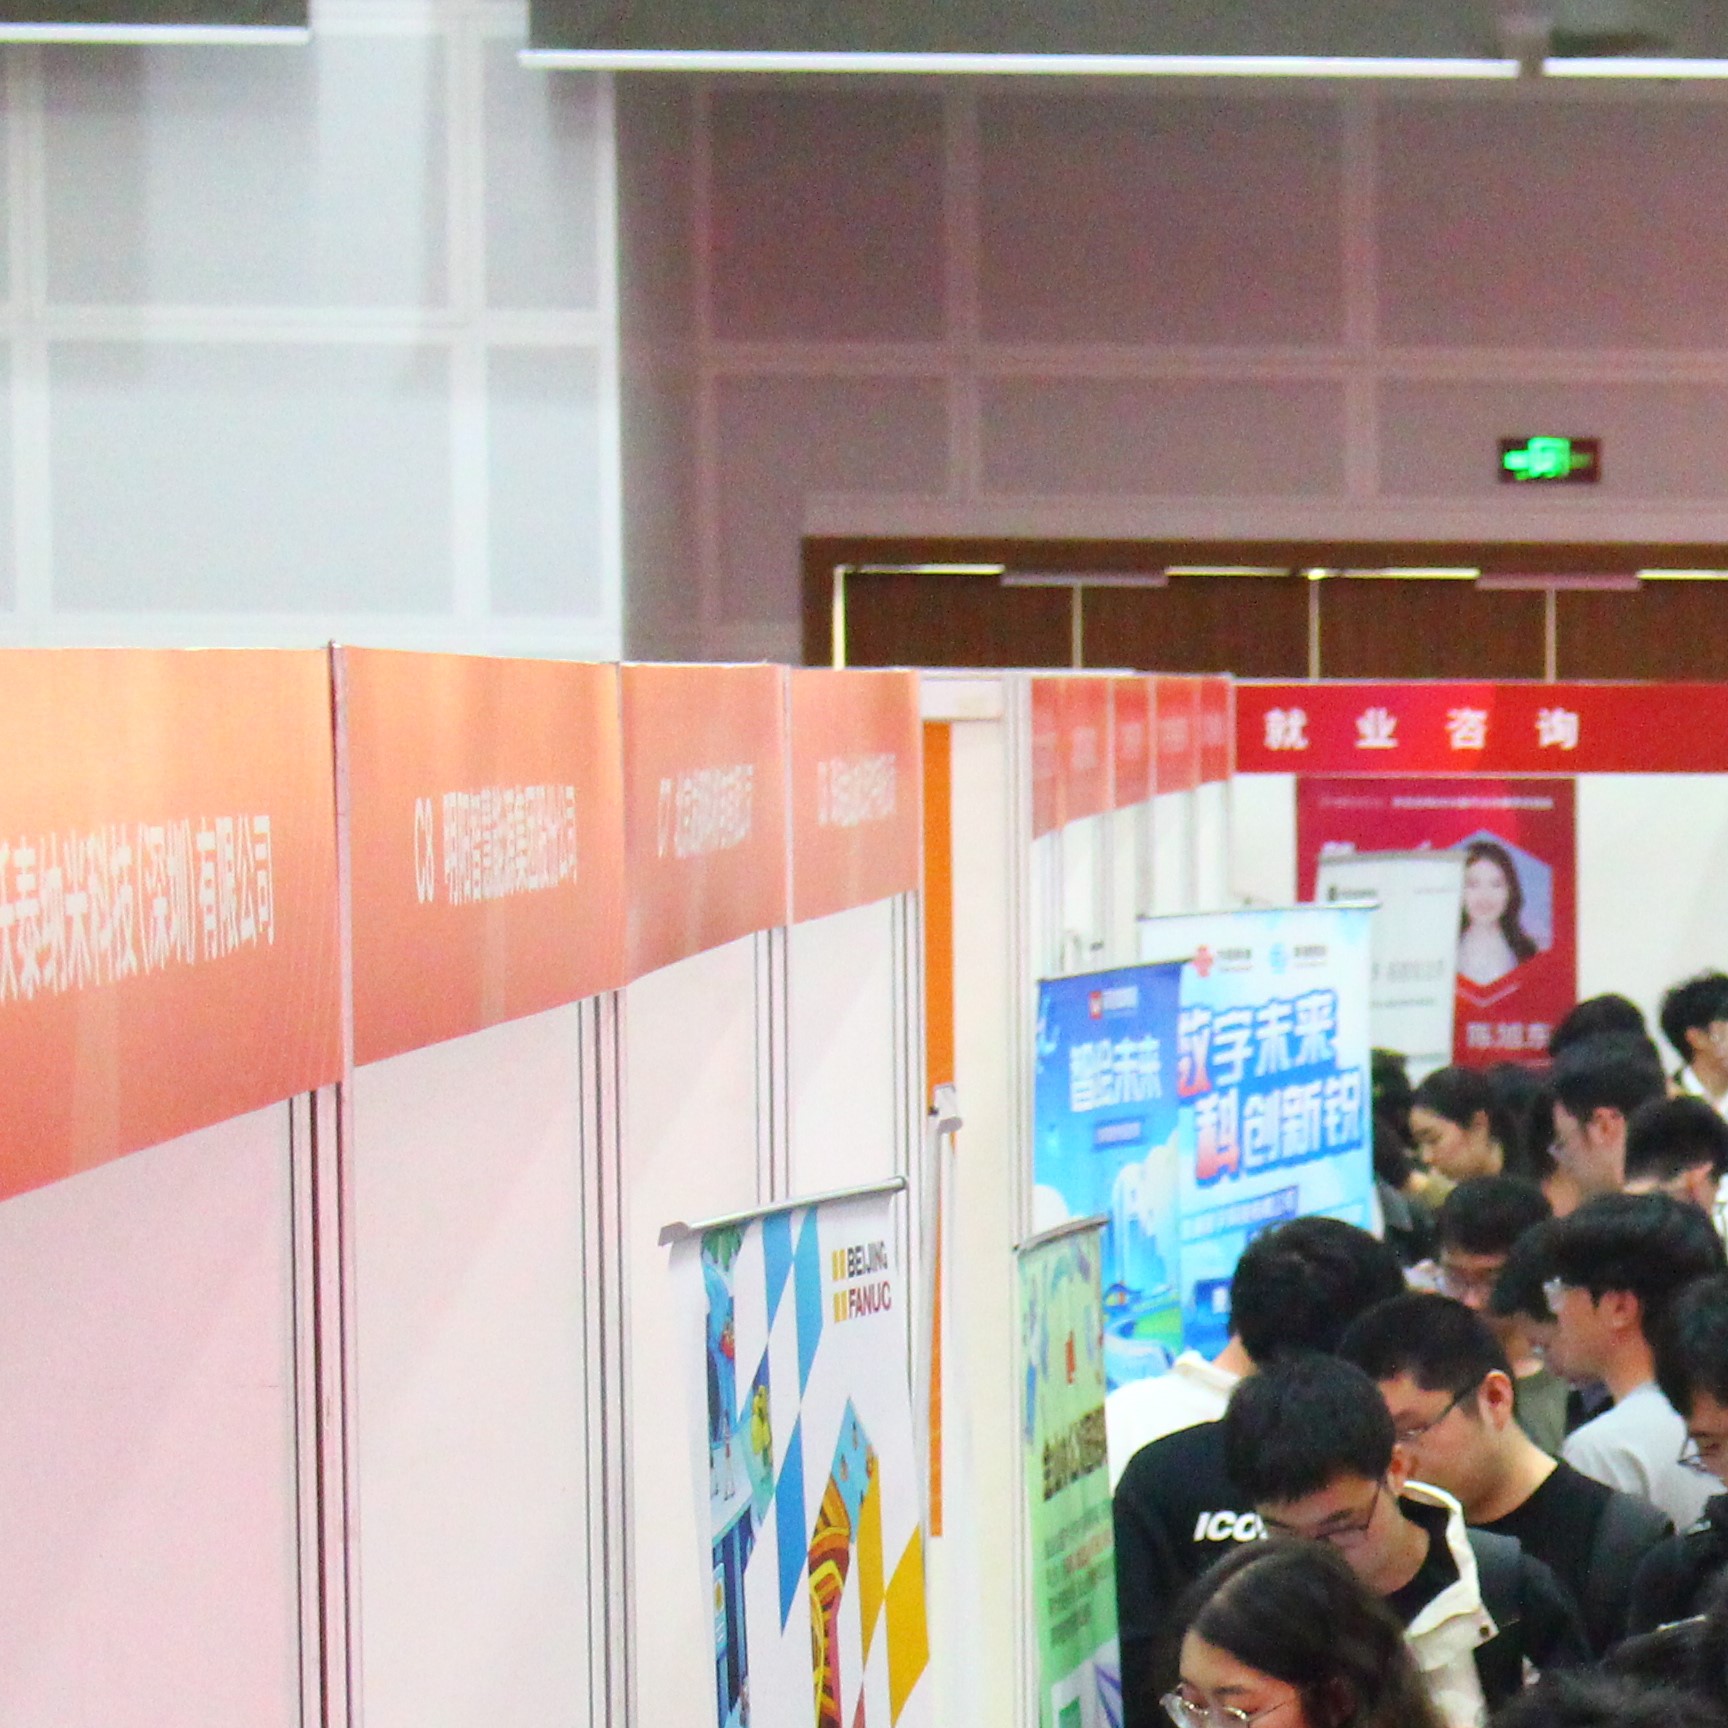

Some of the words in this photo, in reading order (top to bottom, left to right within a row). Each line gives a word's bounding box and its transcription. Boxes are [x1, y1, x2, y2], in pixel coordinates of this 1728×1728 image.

[1263, 706, 1580, 750] 就业咨询
[414, 797, 434, 904] C8
[847, 1239, 888, 1279] BEIJING
[848, 1280, 892, 1320] FANUC
